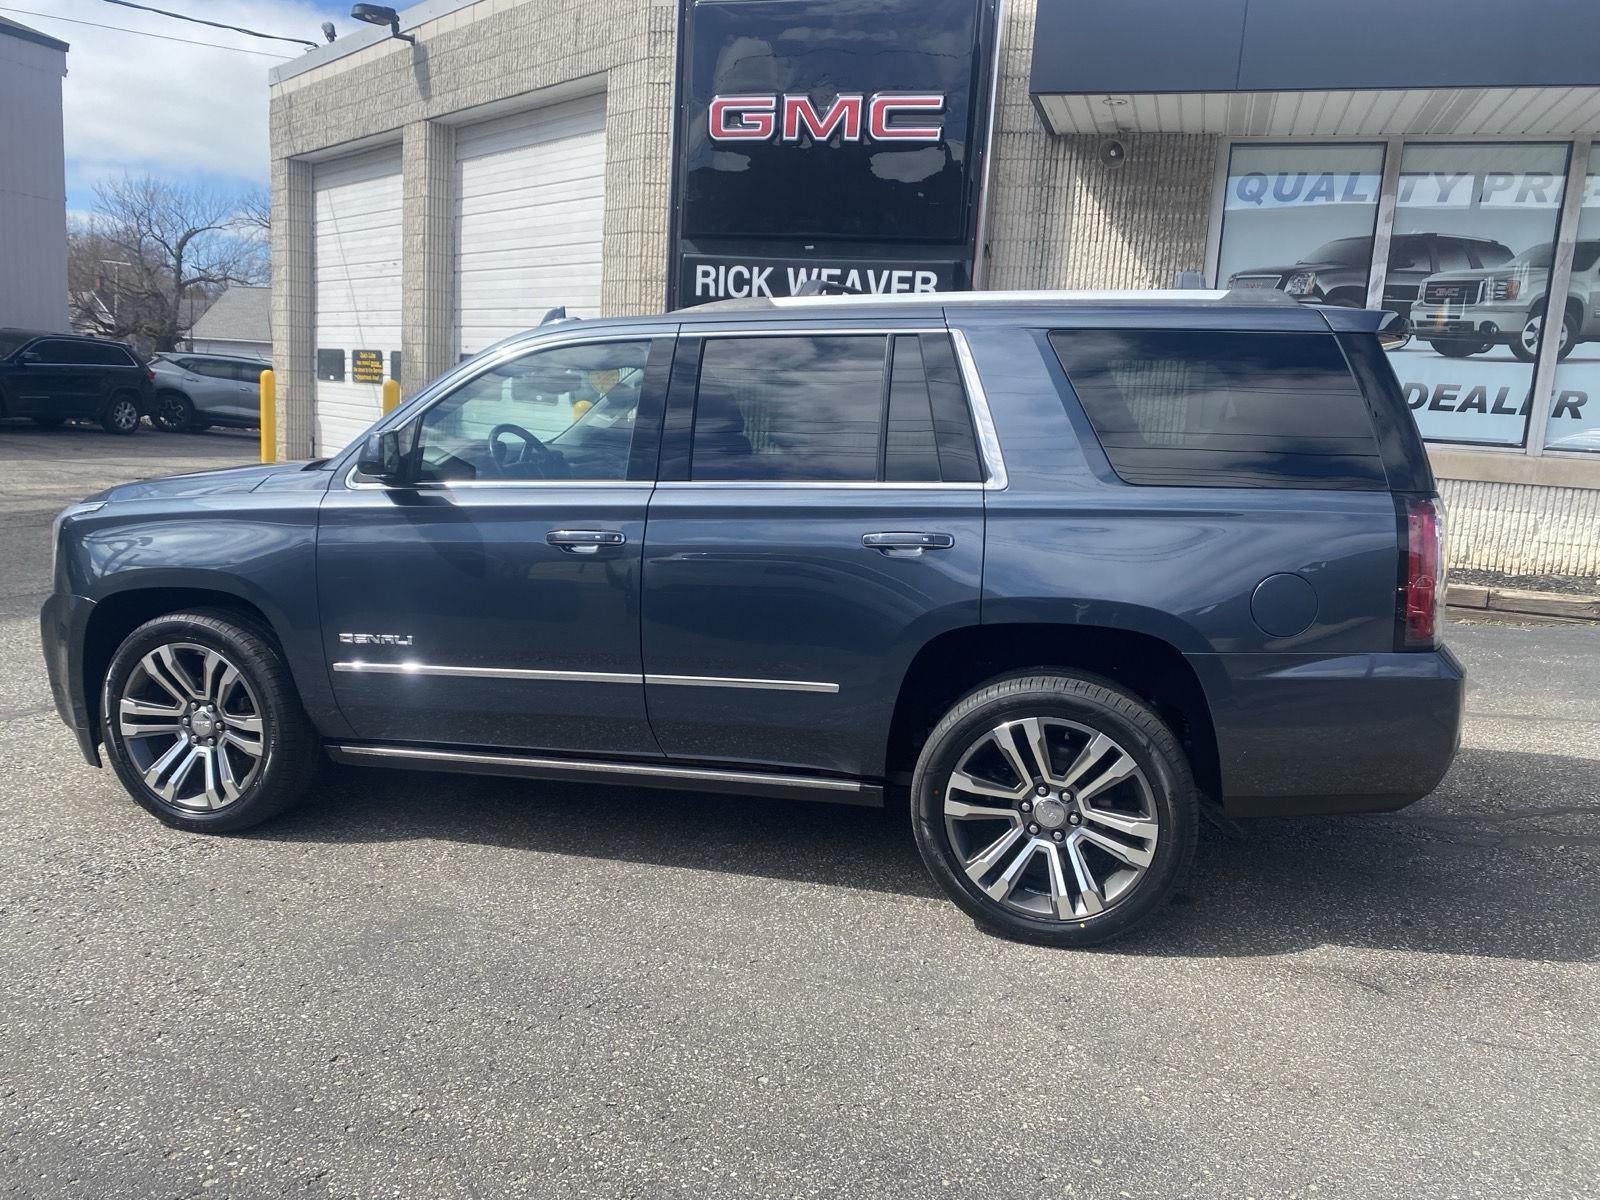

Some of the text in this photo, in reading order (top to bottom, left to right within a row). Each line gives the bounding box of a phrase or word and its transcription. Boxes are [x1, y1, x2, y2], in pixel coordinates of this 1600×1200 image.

[708, 93, 945, 142] GMC
[1236, 171, 1468, 206] QUALTY
[695, 264, 938, 298] RICK WEAVER
[339, 633, 413, 645] DENALI
